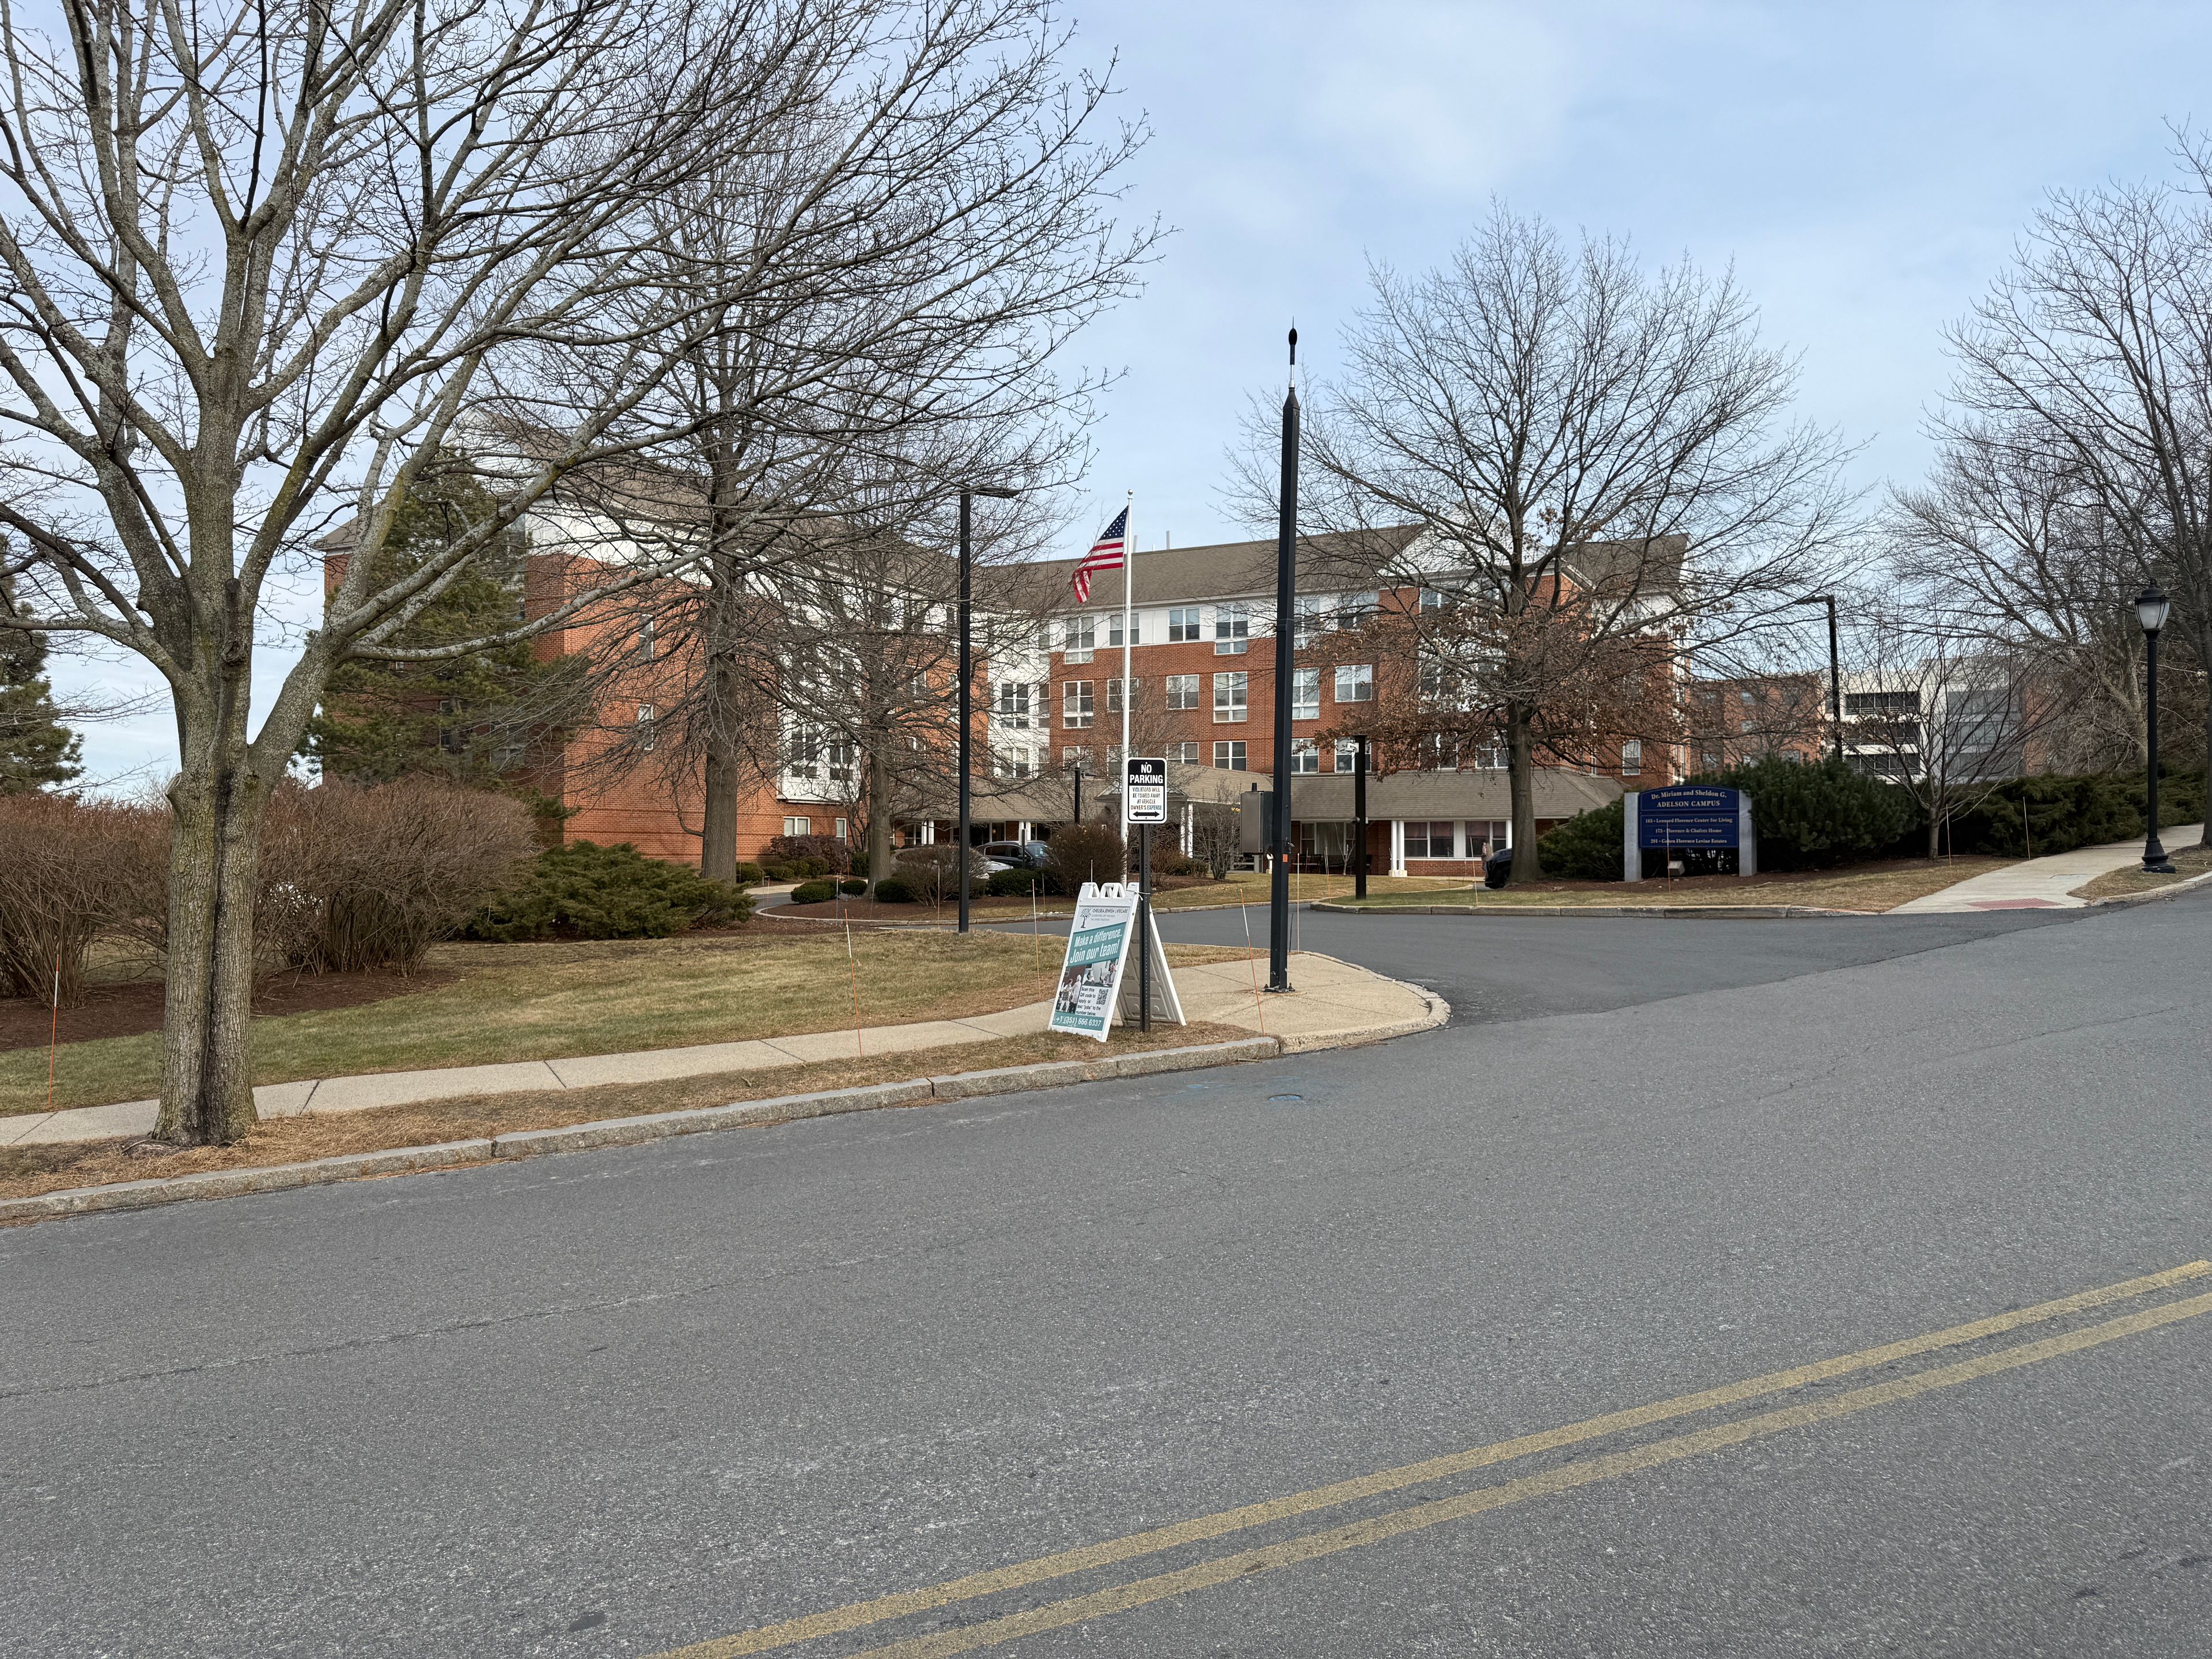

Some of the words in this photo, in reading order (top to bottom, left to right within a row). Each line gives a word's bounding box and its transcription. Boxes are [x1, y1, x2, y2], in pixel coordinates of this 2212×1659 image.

[1141, 764, 1152, 773] NO
[1130, 775, 1163, 783] PARKING
[1074, 935, 1089, 947] Make
[1089, 935, 1093, 944] a
[1070, 948, 1086, 963] Join
[1086, 947, 1100, 960] our
[1100, 939, 1120, 957] team!
[1063, 1016, 1077, 1026] (351)
[1078, 1017, 1088, 1025] 666
[1089, 1018, 1102, 1027] 6337
